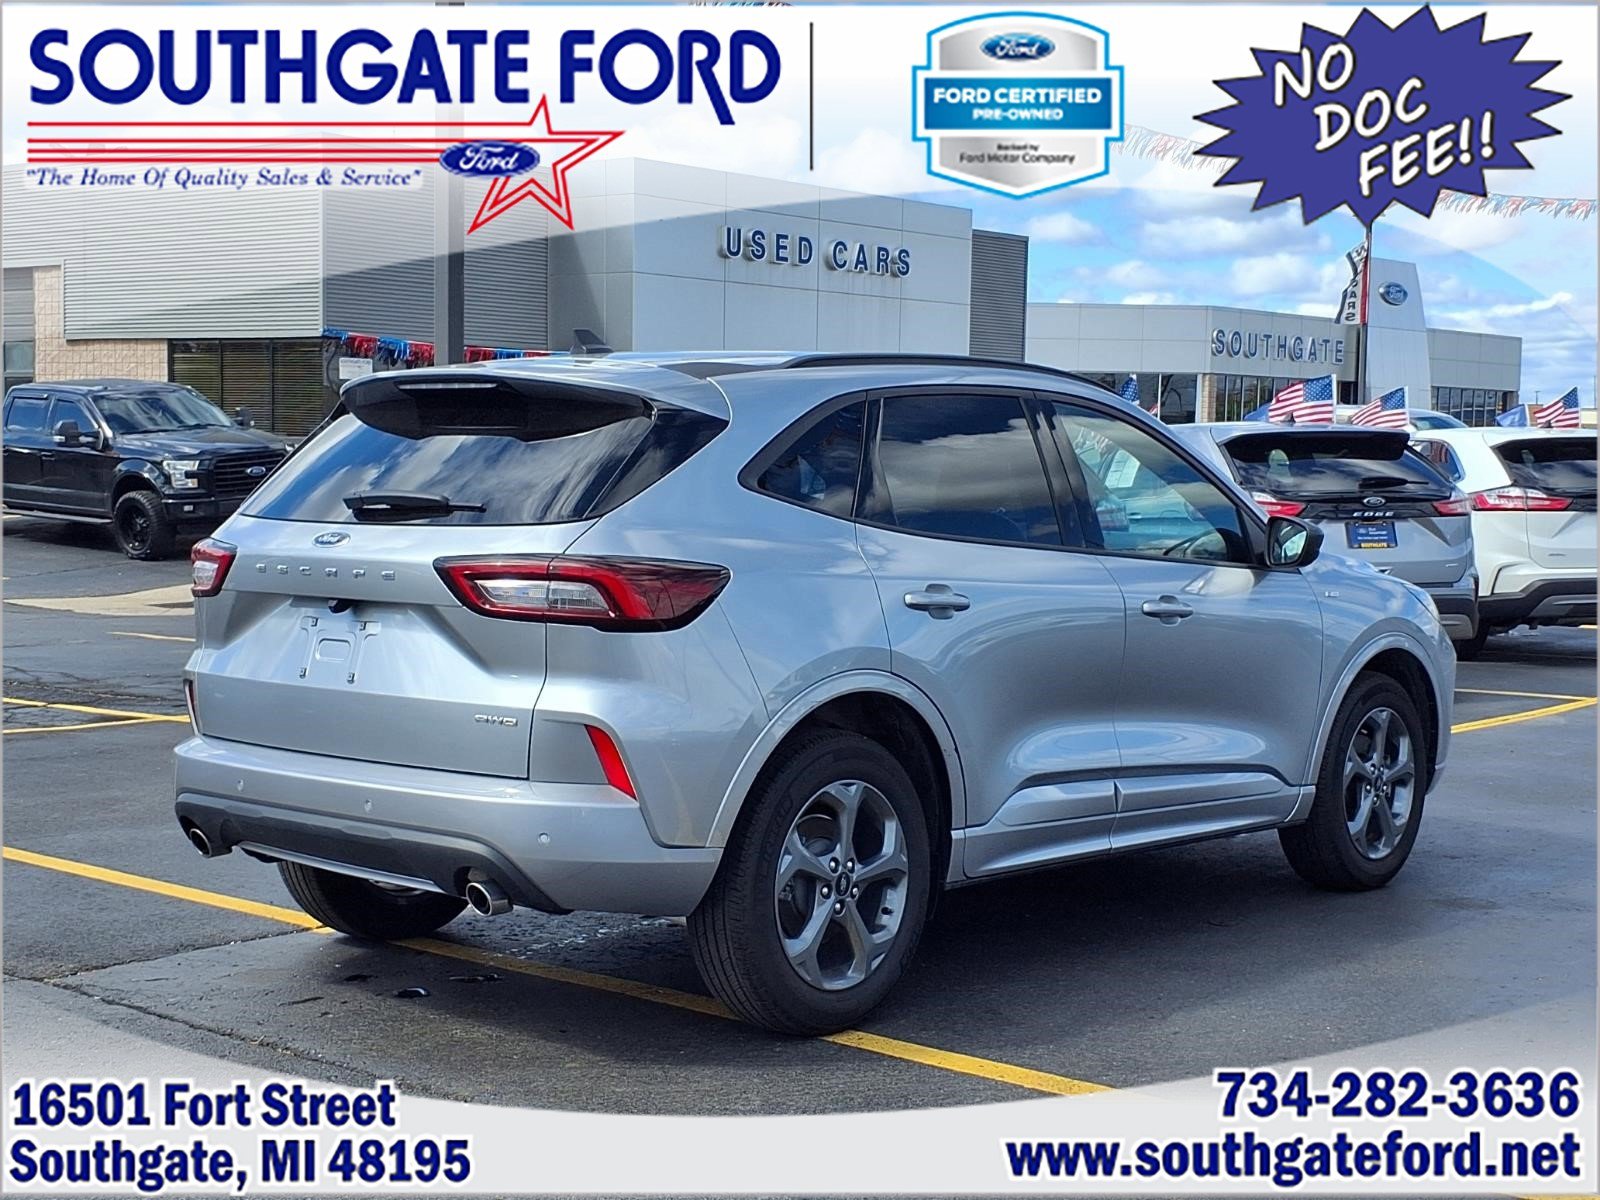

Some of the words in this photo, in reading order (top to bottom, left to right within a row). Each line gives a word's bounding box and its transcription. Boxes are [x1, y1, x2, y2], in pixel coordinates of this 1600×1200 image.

[720, 226, 813, 265] USED
[825, 240, 911, 277] CARS
[1212, 328, 1344, 364] SOUTHGATE
[255, 563, 396, 581] ESCAPE
